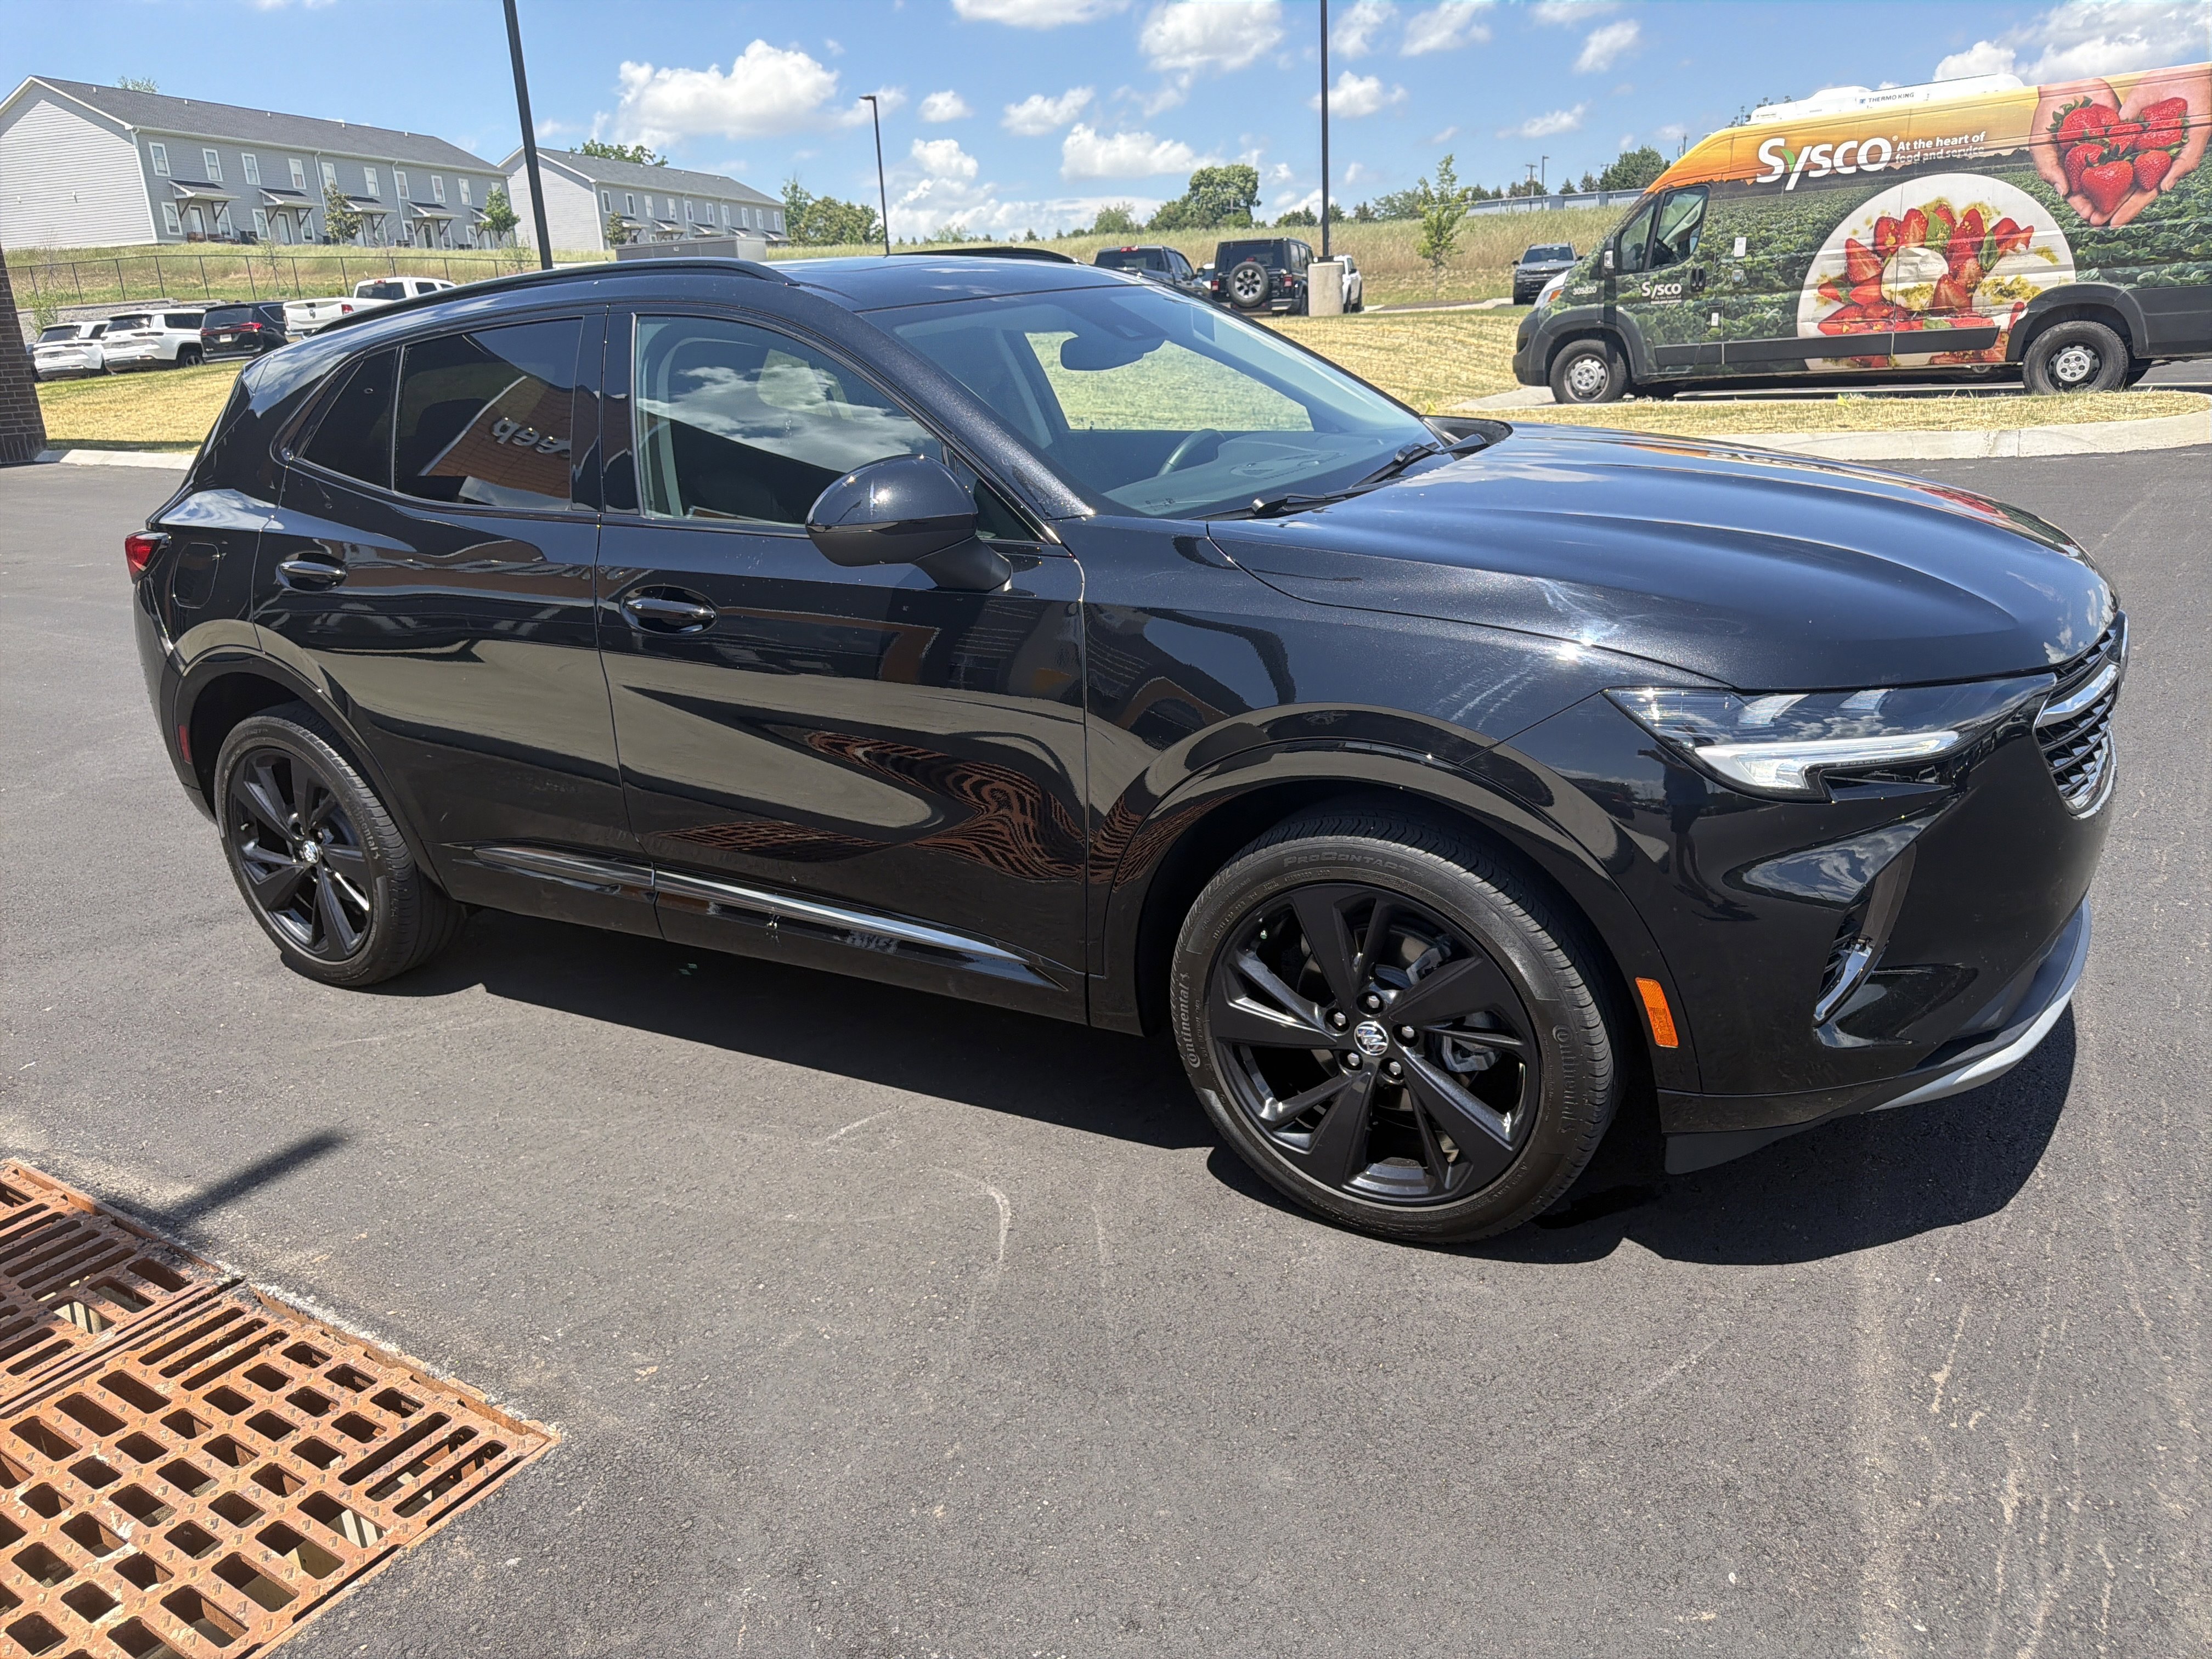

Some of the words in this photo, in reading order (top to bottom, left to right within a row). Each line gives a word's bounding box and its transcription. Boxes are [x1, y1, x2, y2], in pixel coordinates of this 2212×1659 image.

[1869, 94, 1897, 103] THERMO
[1897, 141, 1911, 151] At
[1913, 138, 1933, 150] the
[1936, 134, 1970, 147] heart
[1971, 131, 1986, 143] of
[1895, 151, 1921, 164] food
[1922, 148, 1944, 160] and
[1945, 145, 1984, 159] service
[1179, 982, 1200, 1069] Continental
